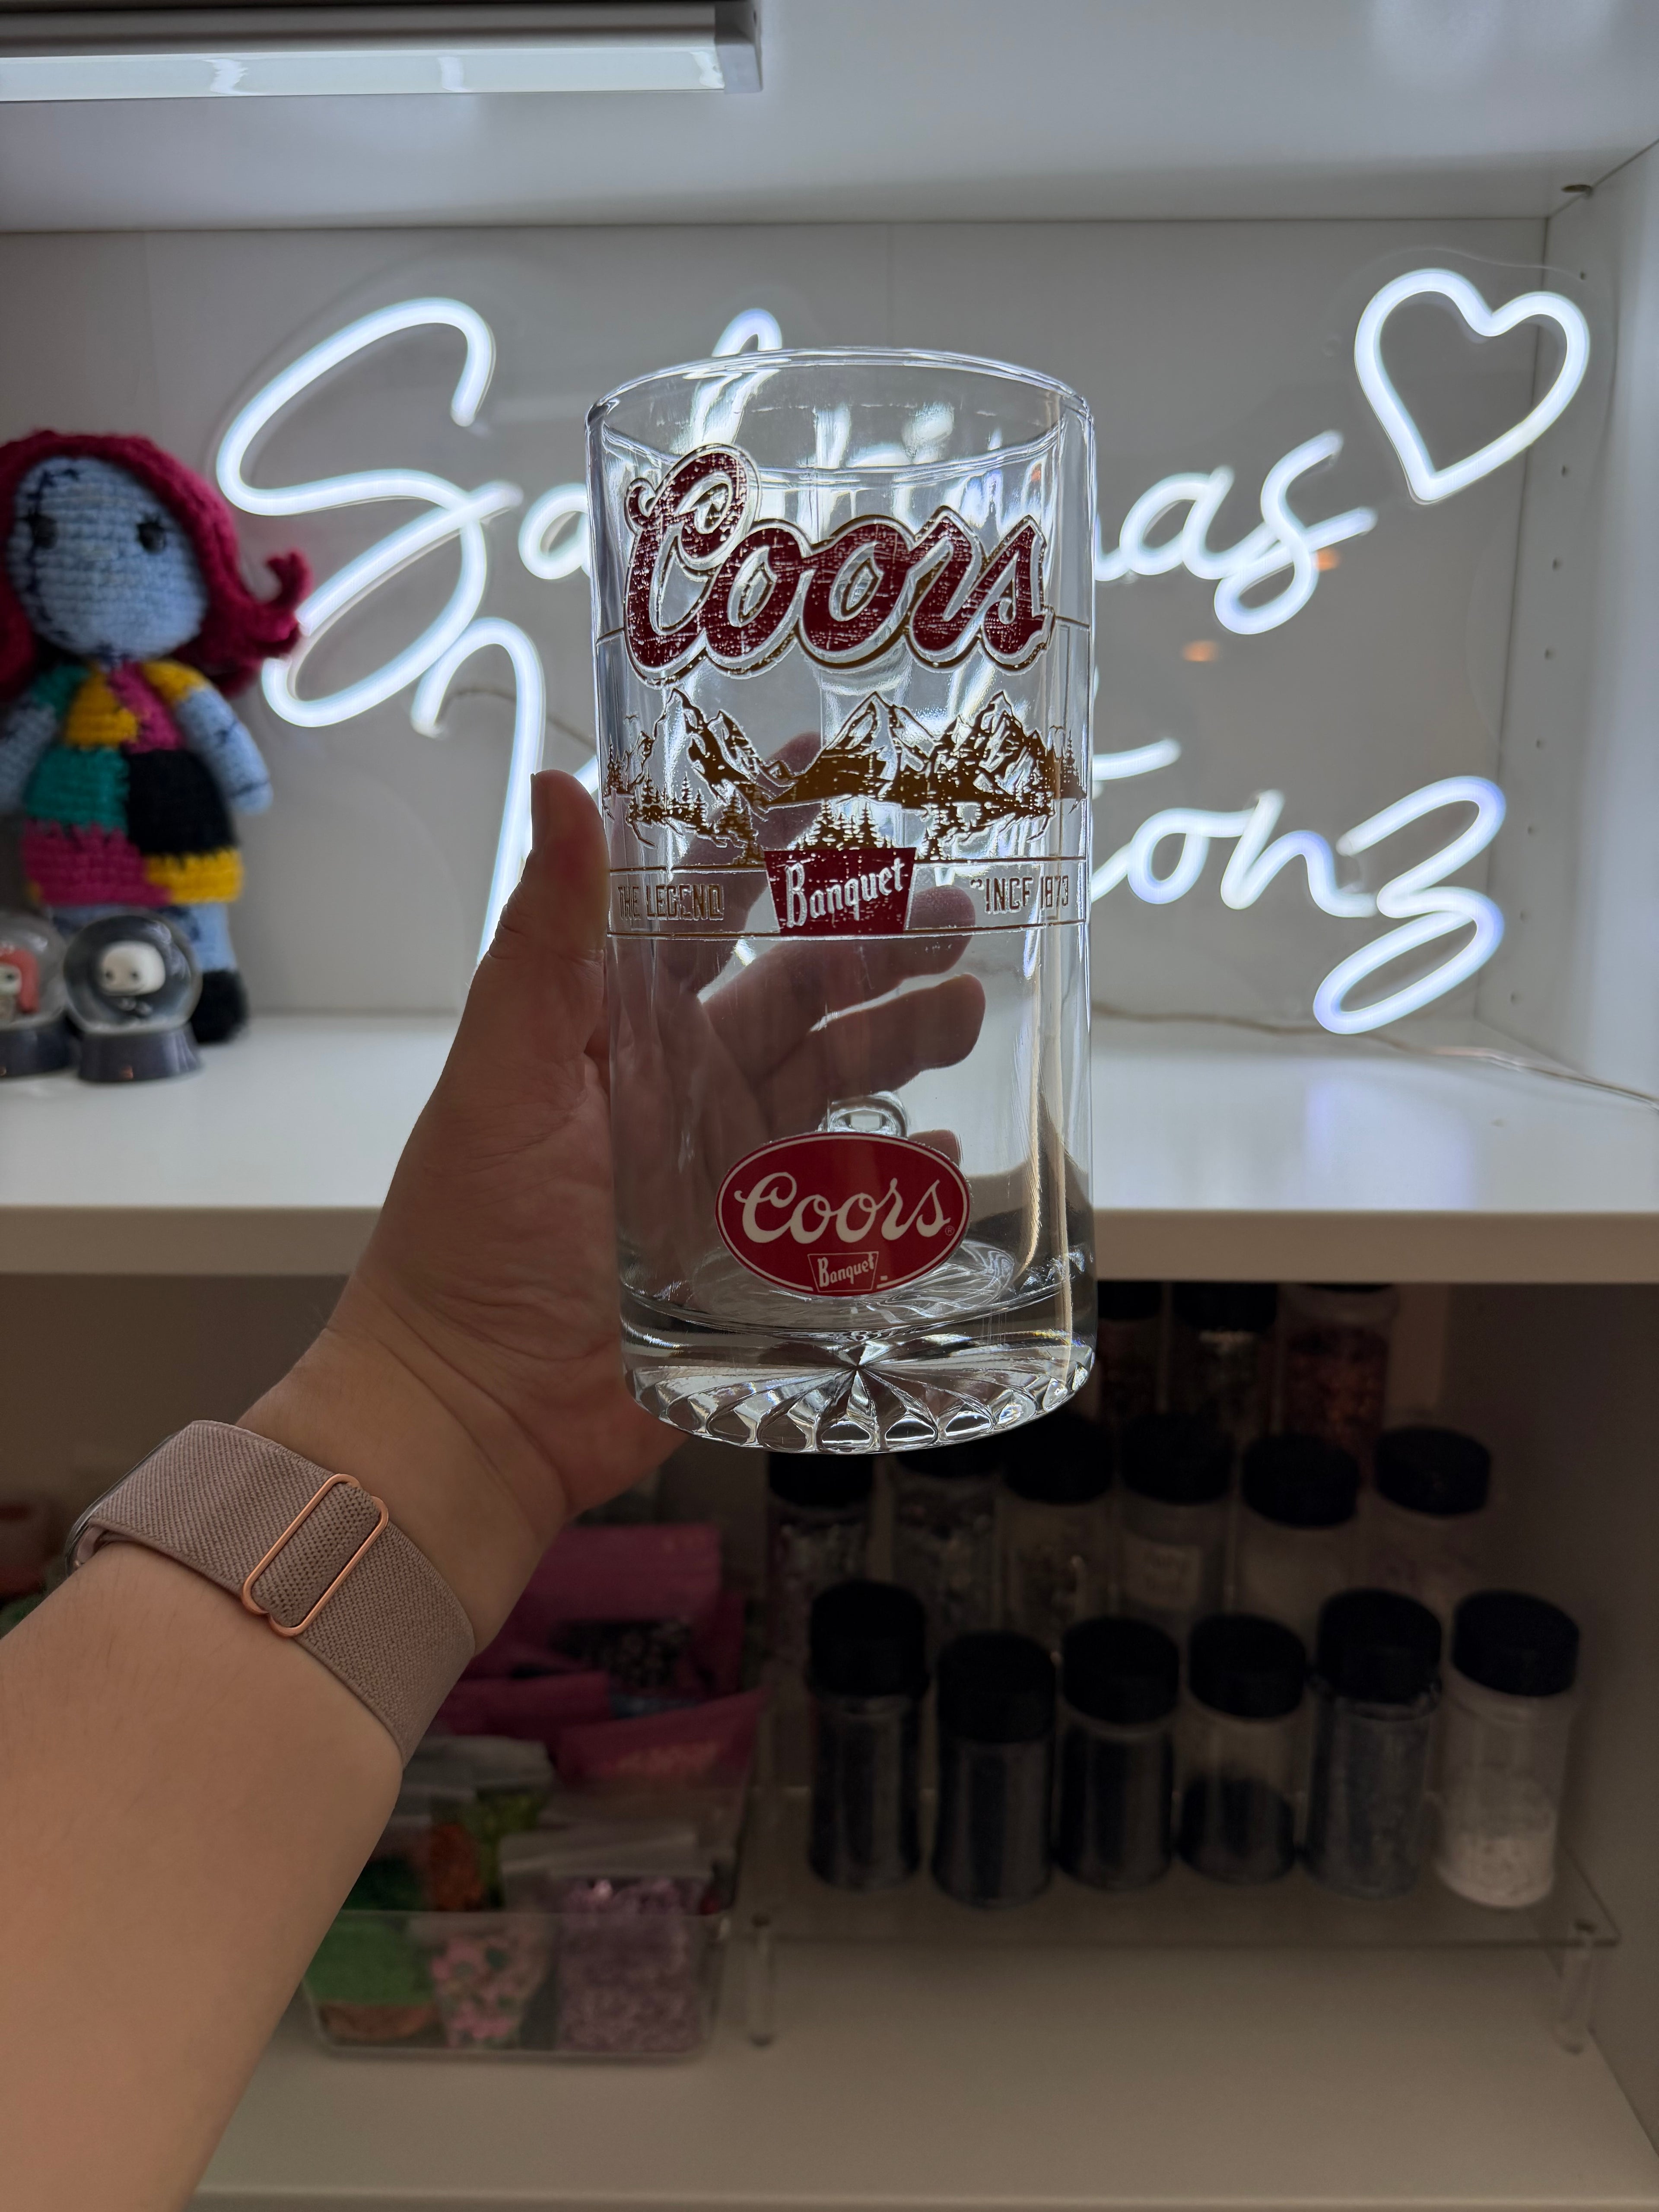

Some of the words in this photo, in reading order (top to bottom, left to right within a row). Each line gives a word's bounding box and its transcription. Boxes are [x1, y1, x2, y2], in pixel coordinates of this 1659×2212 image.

[624, 444, 1054, 686] Coors
[618, 885, 642, 919] THE
[646, 884, 724, 920] LEGEND
[785, 857, 905, 928] Banquet
[817, 1252, 874, 1288] Banquet
